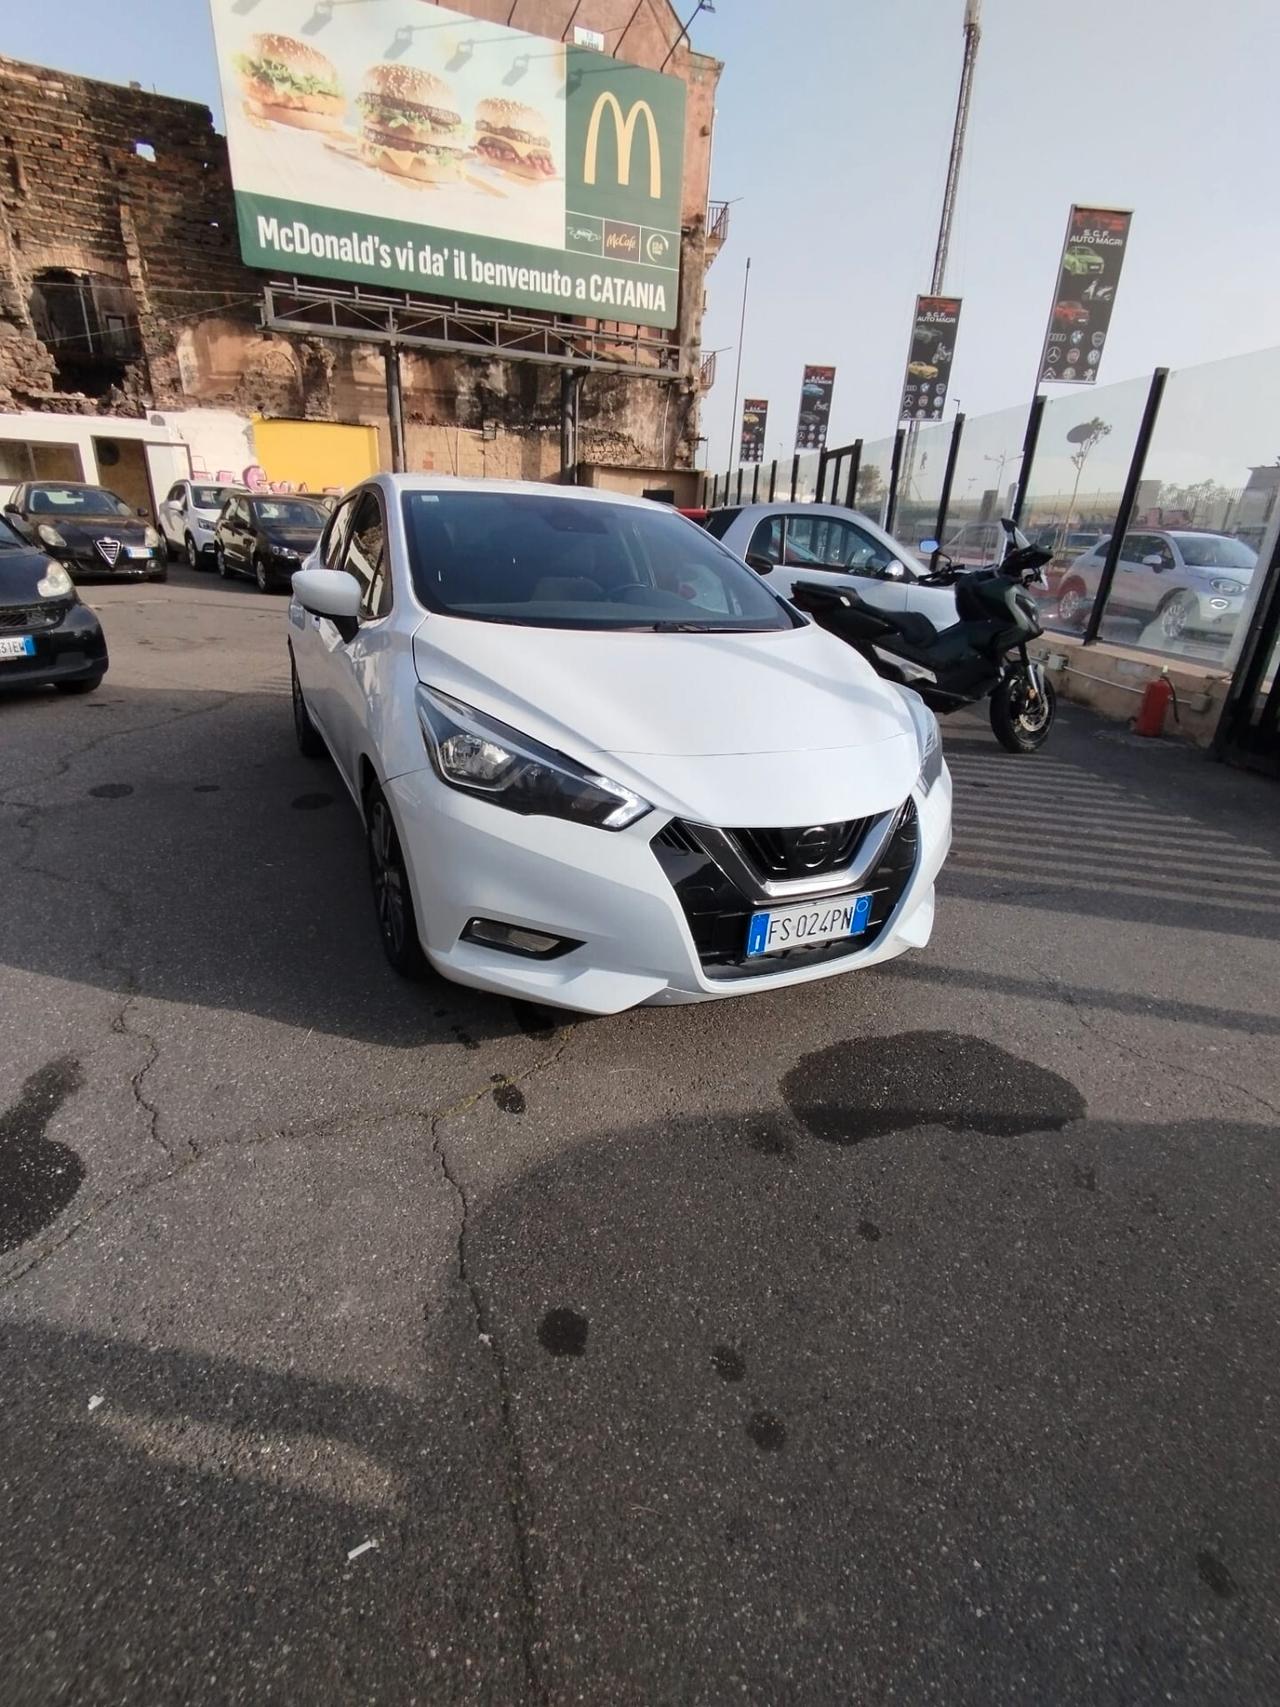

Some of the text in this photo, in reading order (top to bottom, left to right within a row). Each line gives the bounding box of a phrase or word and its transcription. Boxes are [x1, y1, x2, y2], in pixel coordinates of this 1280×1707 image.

[257, 215, 666, 312] McDonald's vi da' il benvenuto a CATANIA
[1070, 235, 1095, 244] AUTO
